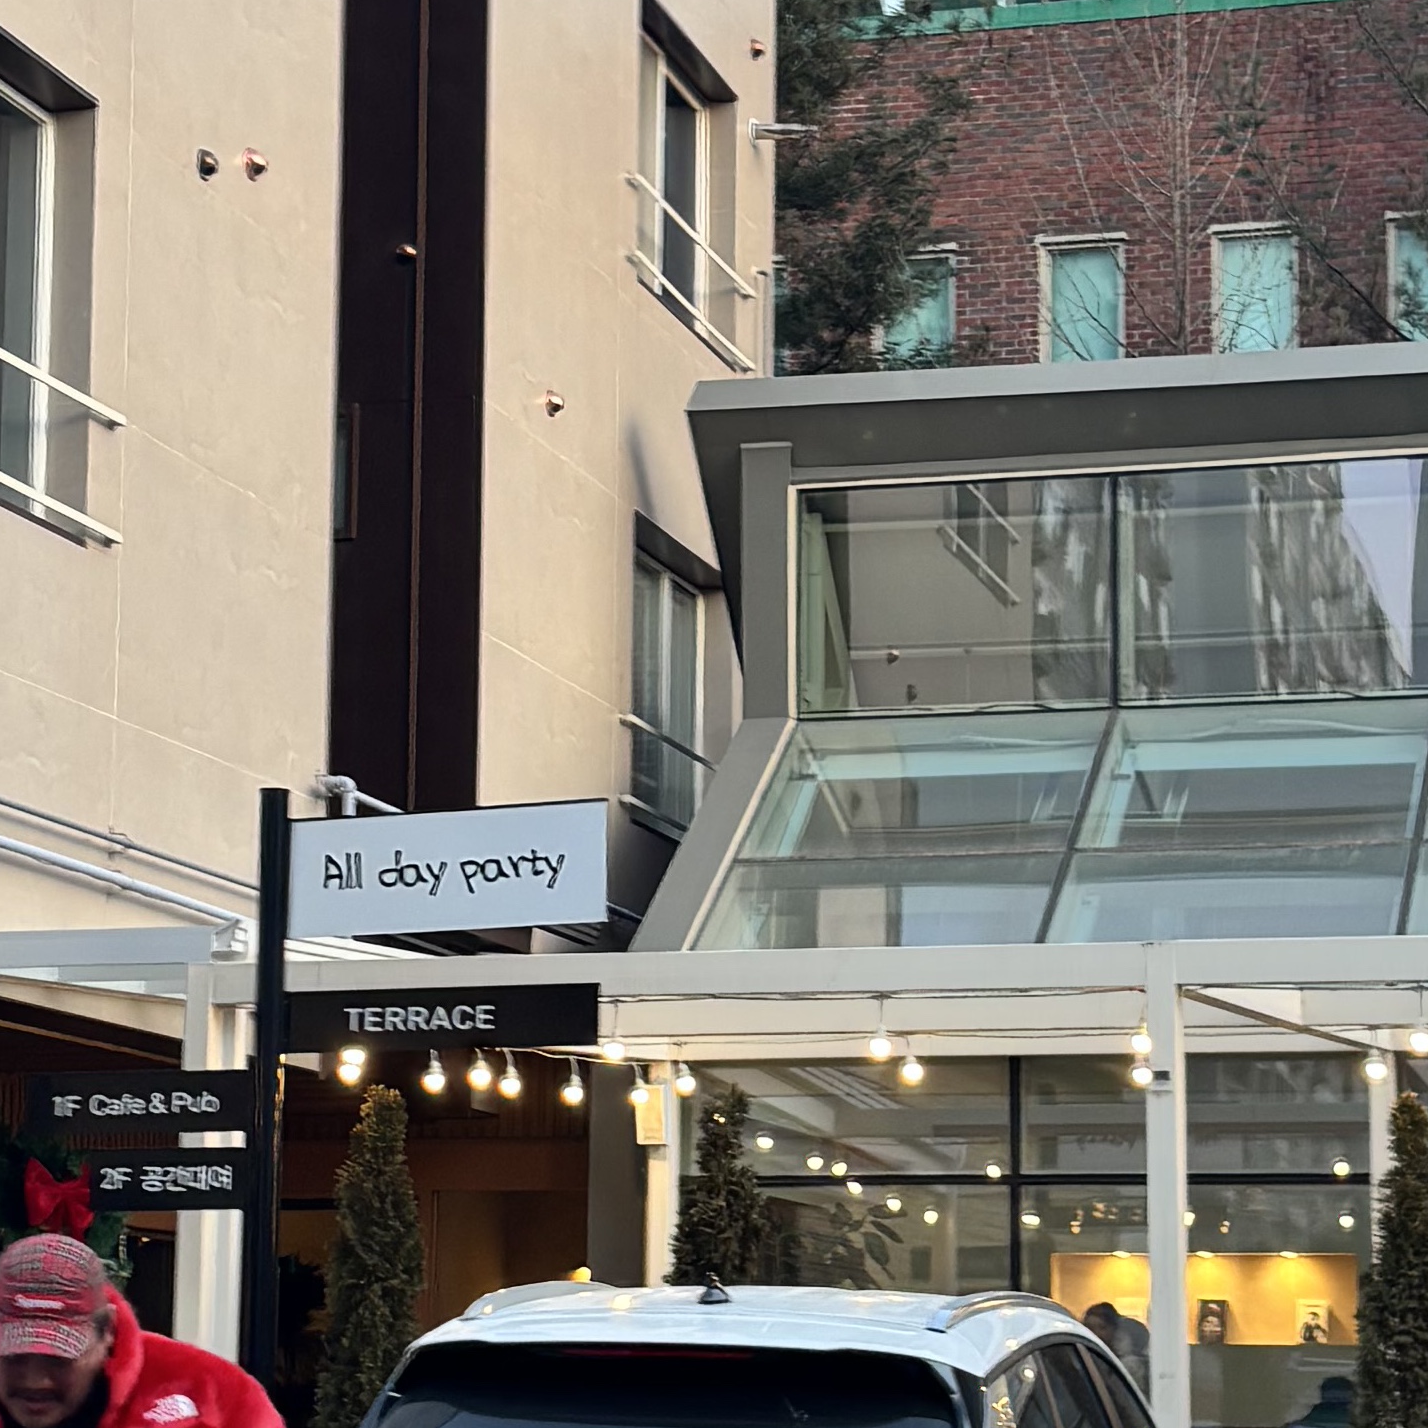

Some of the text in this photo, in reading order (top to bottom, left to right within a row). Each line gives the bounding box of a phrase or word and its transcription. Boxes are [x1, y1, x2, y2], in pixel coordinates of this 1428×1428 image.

[323, 848, 566, 897] All day party
[343, 1004, 497, 1033] TERRACE
[52, 1094, 83, 1118] 1F
[88, 1093, 147, 1117] Cafe
[99, 1166, 134, 1191] 2F
